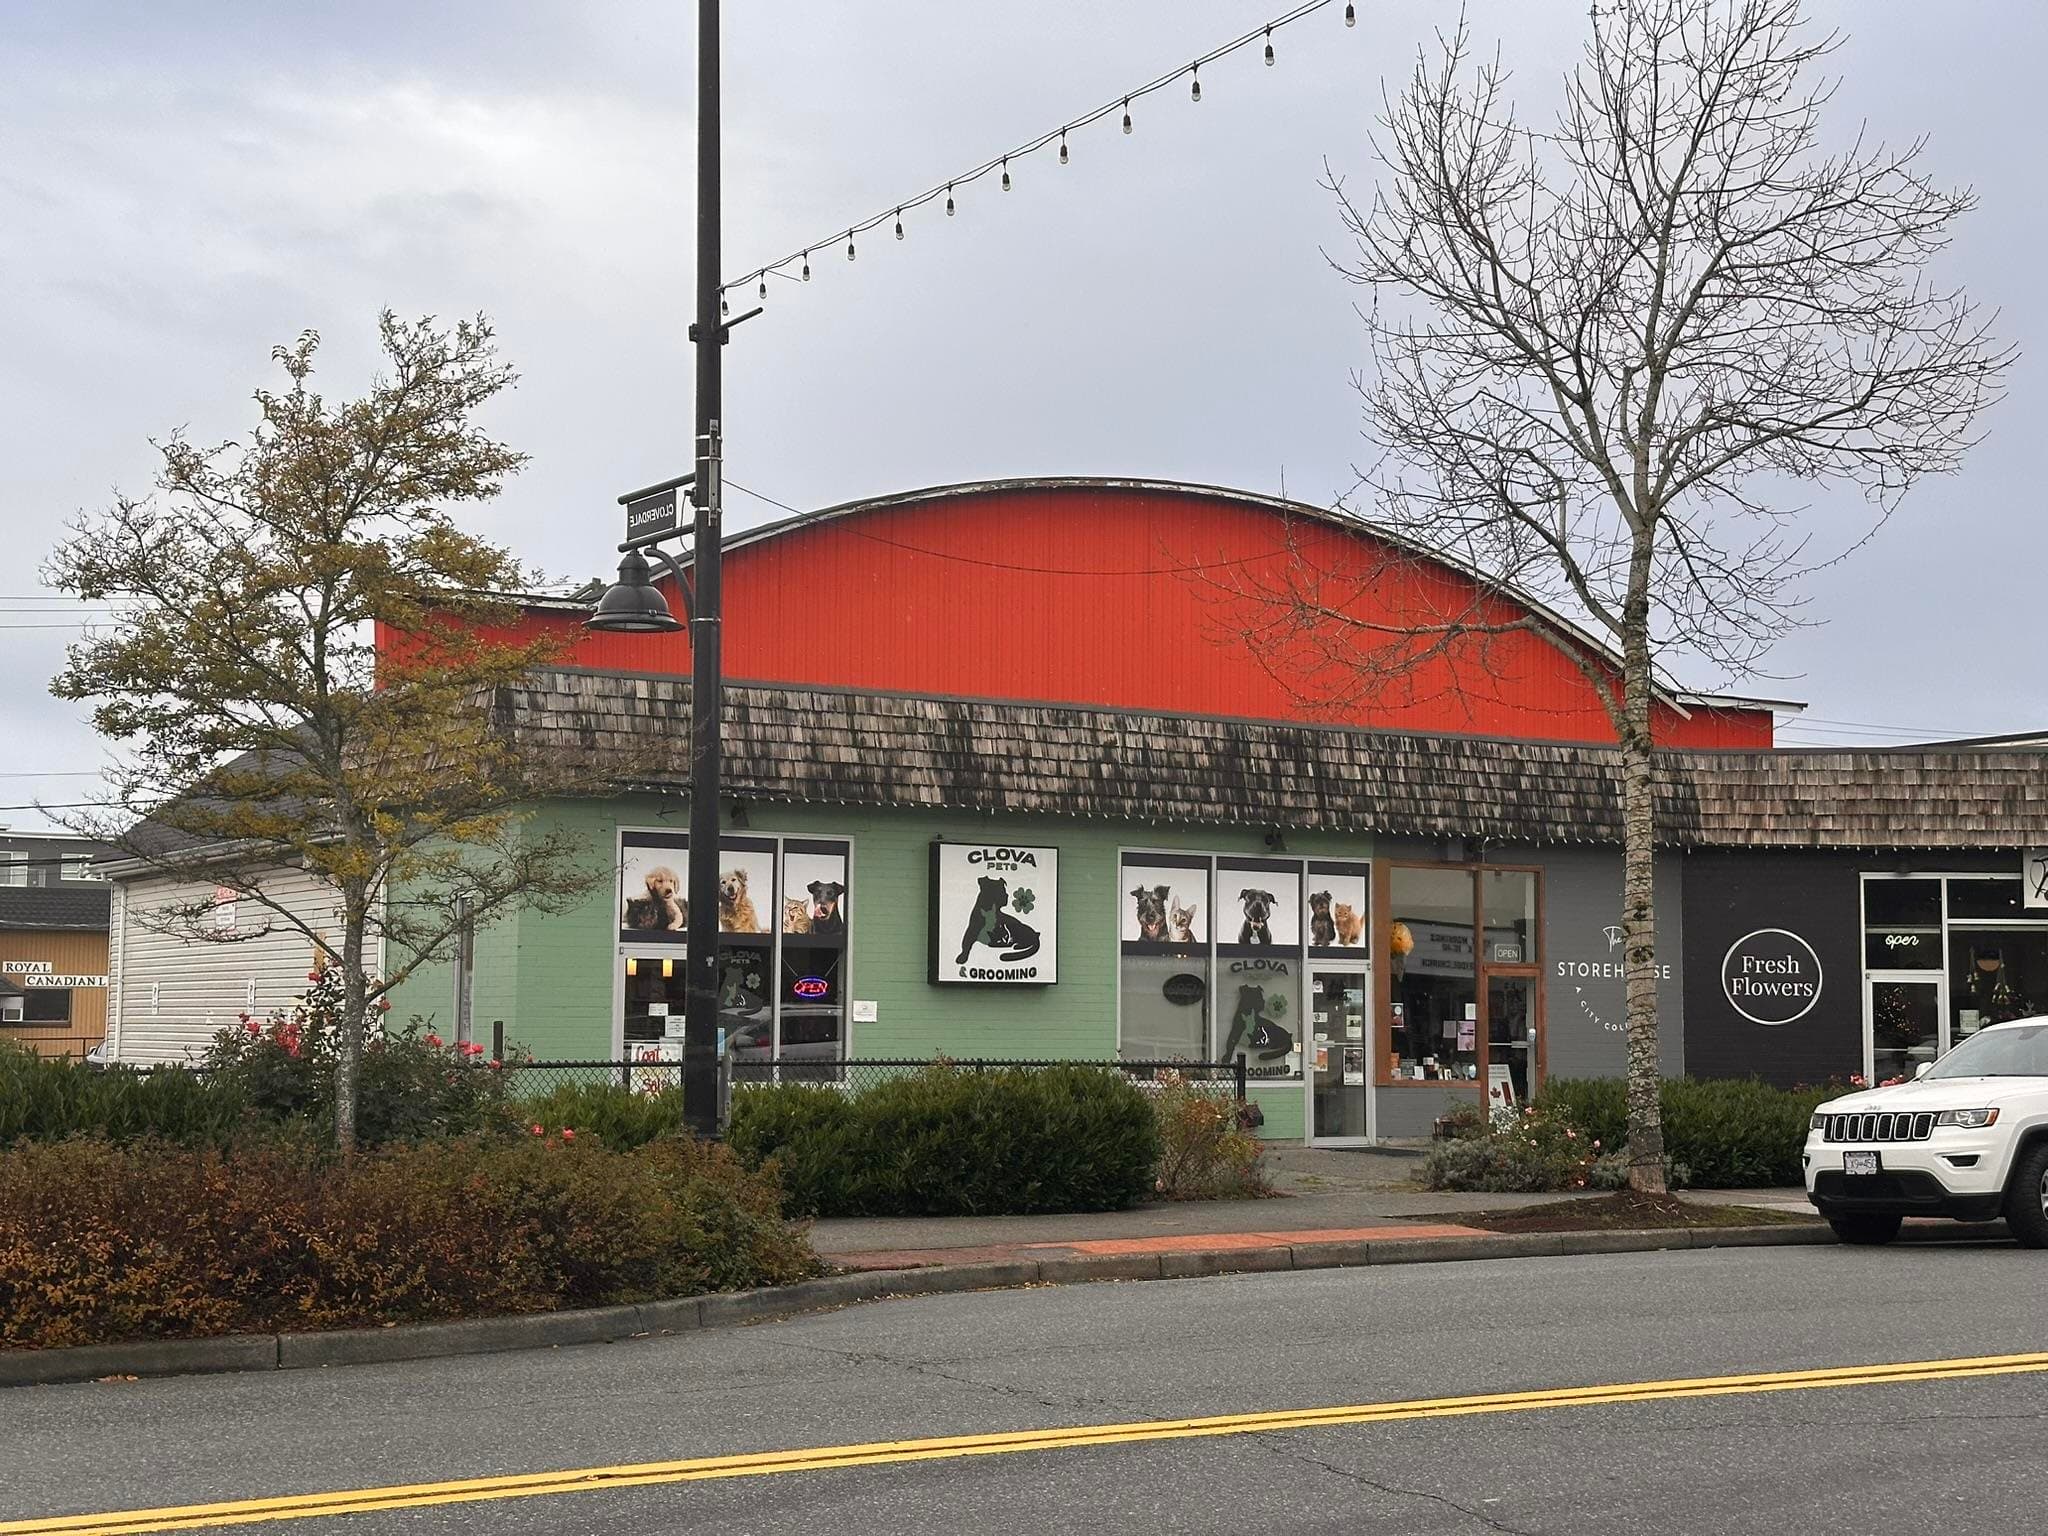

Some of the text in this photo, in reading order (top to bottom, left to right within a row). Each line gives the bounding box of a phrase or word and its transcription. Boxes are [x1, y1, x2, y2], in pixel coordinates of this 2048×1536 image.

[967, 848, 1037, 868] CLOVA
[986, 862, 1018, 871] PETS
[1603, 926, 1623, 953] The
[1885, 934, 1920, 950] open
[1497, 949, 1518, 958] OPEN
[6, 962, 50, 973] ROYAL
[1230, 959, 1289, 976] CLOVA
[1557, 961, 1671, 979] STOREHSE
[1742, 954, 1801, 974] Fresh
[26, 976, 95, 986] CANADIAN
[959, 966, 1038, 980] & GROOMING
[794, 981, 828, 994] OPEN
[1731, 977, 1814, 997] Flowers
[1580, 1000, 1601, 1023] CITY
